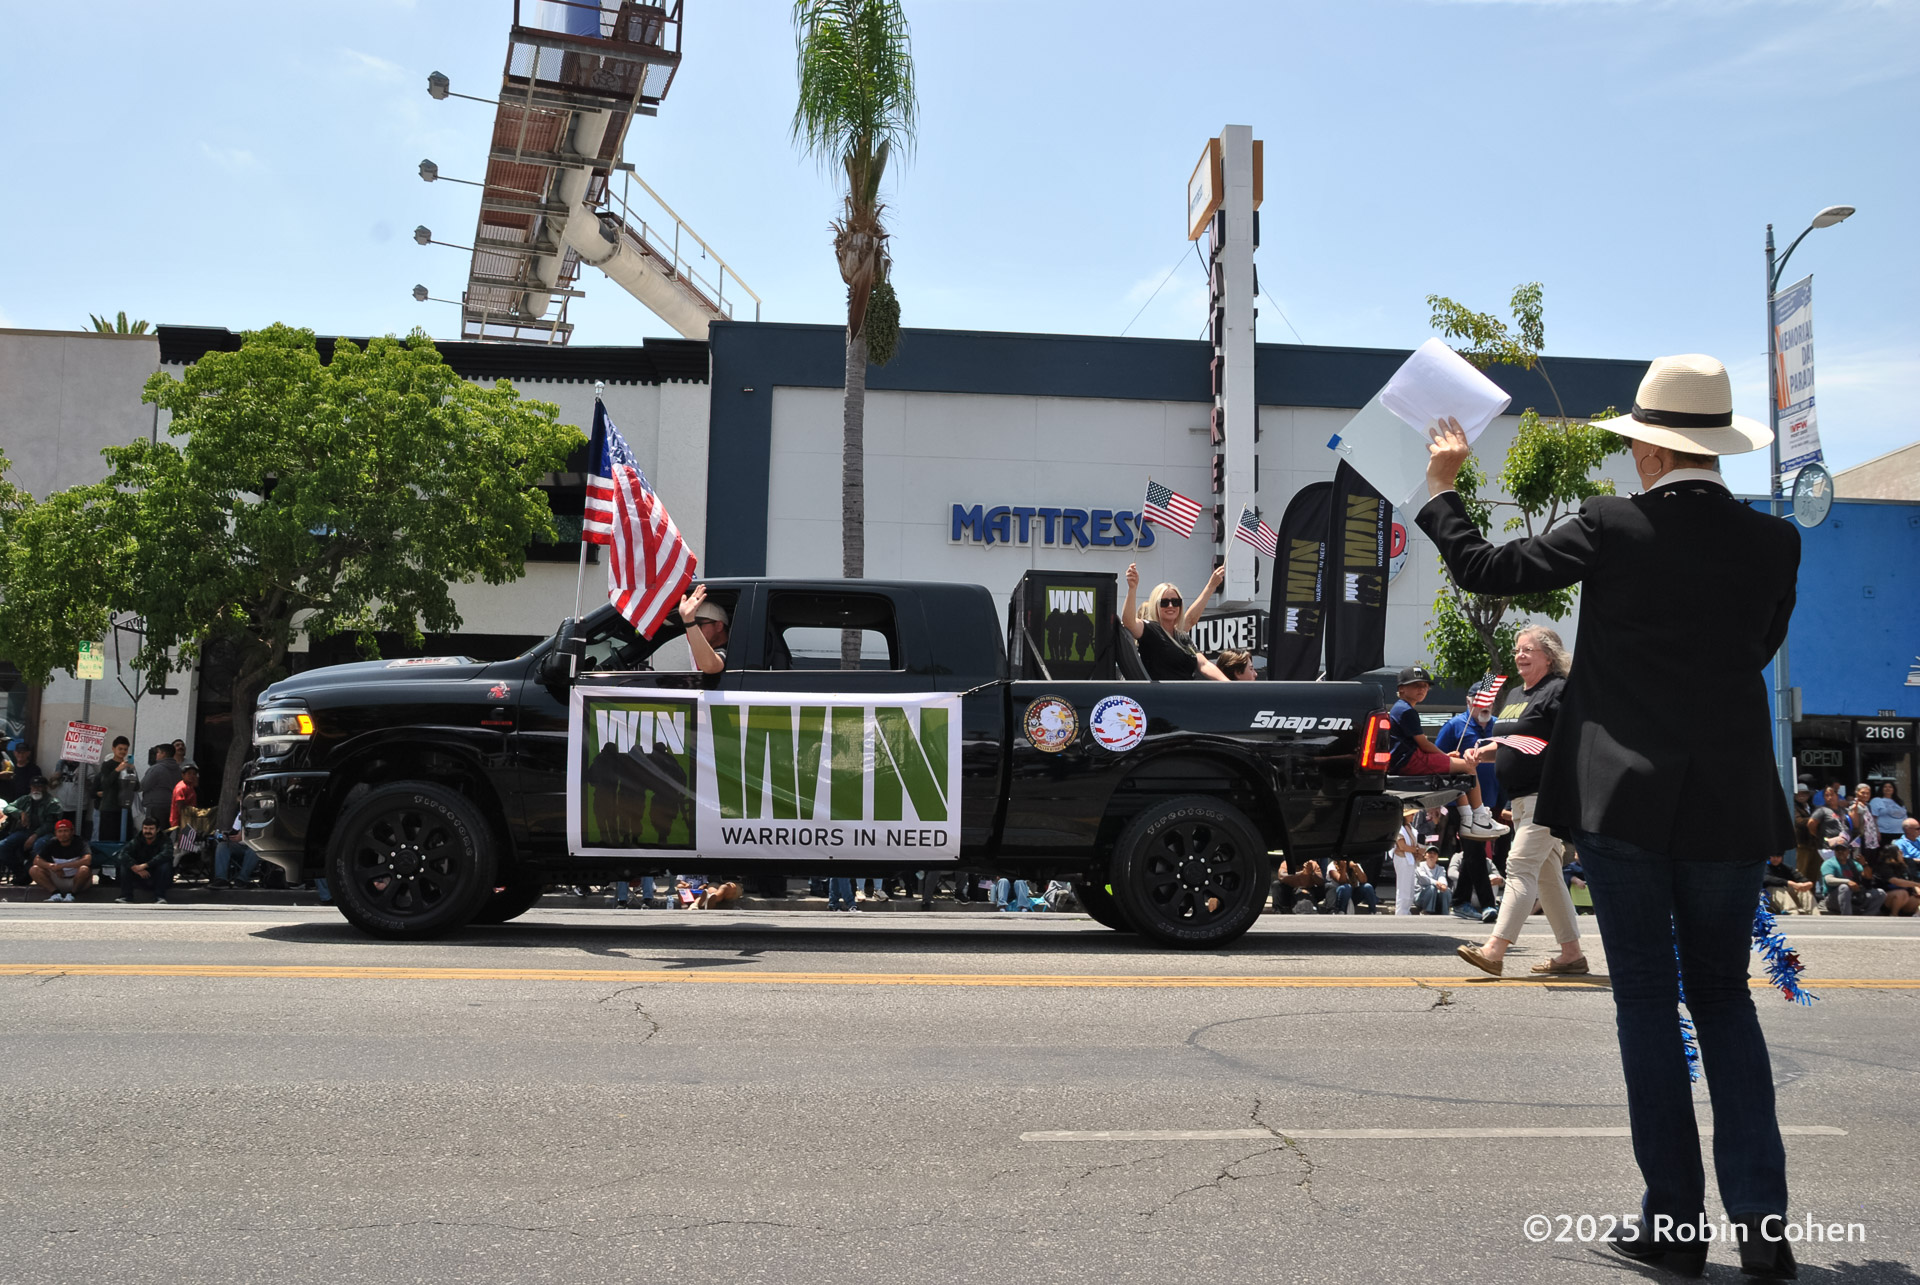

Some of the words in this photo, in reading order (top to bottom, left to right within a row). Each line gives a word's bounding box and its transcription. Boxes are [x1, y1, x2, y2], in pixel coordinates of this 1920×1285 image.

[952, 504, 1155, 548] MATTRESS
[1344, 494, 1378, 566] WIN
[1378, 520, 1383, 529] IN
[1286, 539, 1319, 601] WIN
[1319, 560, 1324, 568] IN
[1049, 590, 1093, 614] WIN
[1190, 615, 1250, 652] ITURE
[82, 643, 88, 651] 2
[67, 732, 79, 742] NO
[80, 735, 103, 746] STOPPING
[596, 709, 685, 755] WIN
[1866, 727, 1905, 738] 21616
[710, 704, 949, 821] WIN
[1803, 751, 1841, 765] OPEN
[721, 827, 844, 846] WARRIORS
[854, 828, 876, 846] IN
[886, 829, 948, 847] NEED
